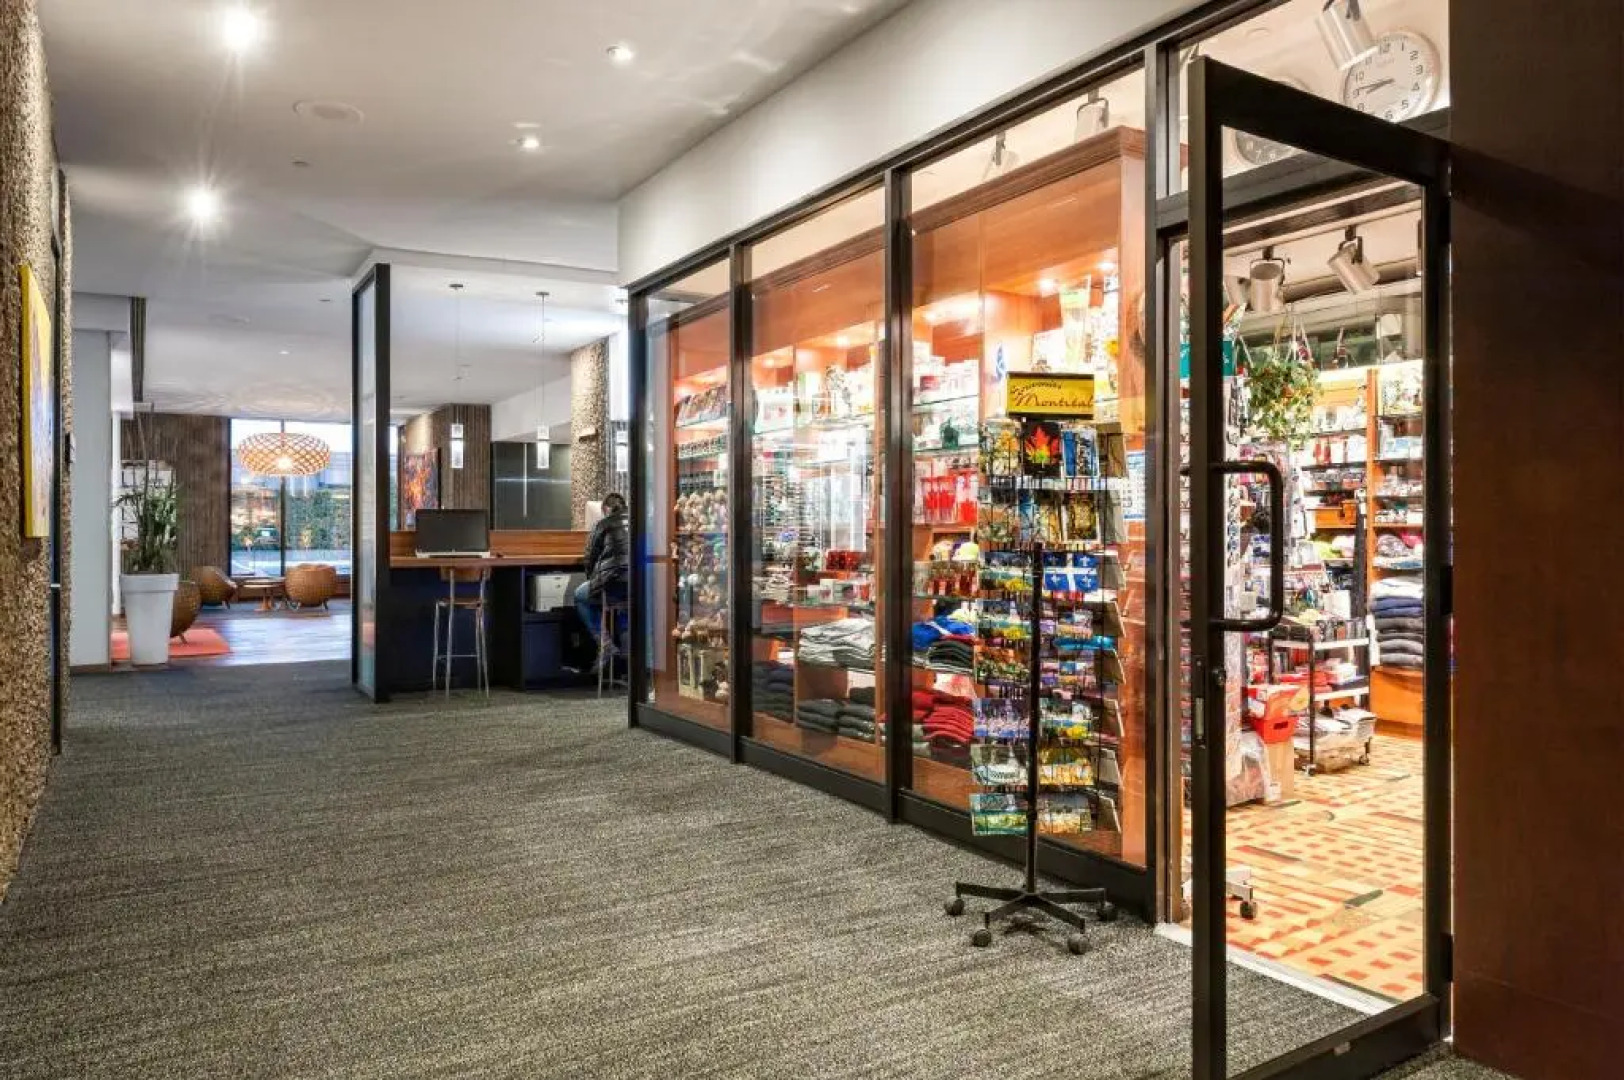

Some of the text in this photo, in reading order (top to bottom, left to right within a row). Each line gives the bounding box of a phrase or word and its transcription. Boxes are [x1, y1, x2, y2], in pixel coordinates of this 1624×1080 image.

[1409, 50, 1419, 61] 2
[1415, 64, 1423, 75] 3
[1355, 71, 1364, 83] 10
[1411, 82, 1420, 91] 4
[1352, 88, 1360, 98] 9
[1402, 99, 1409, 109] 5
